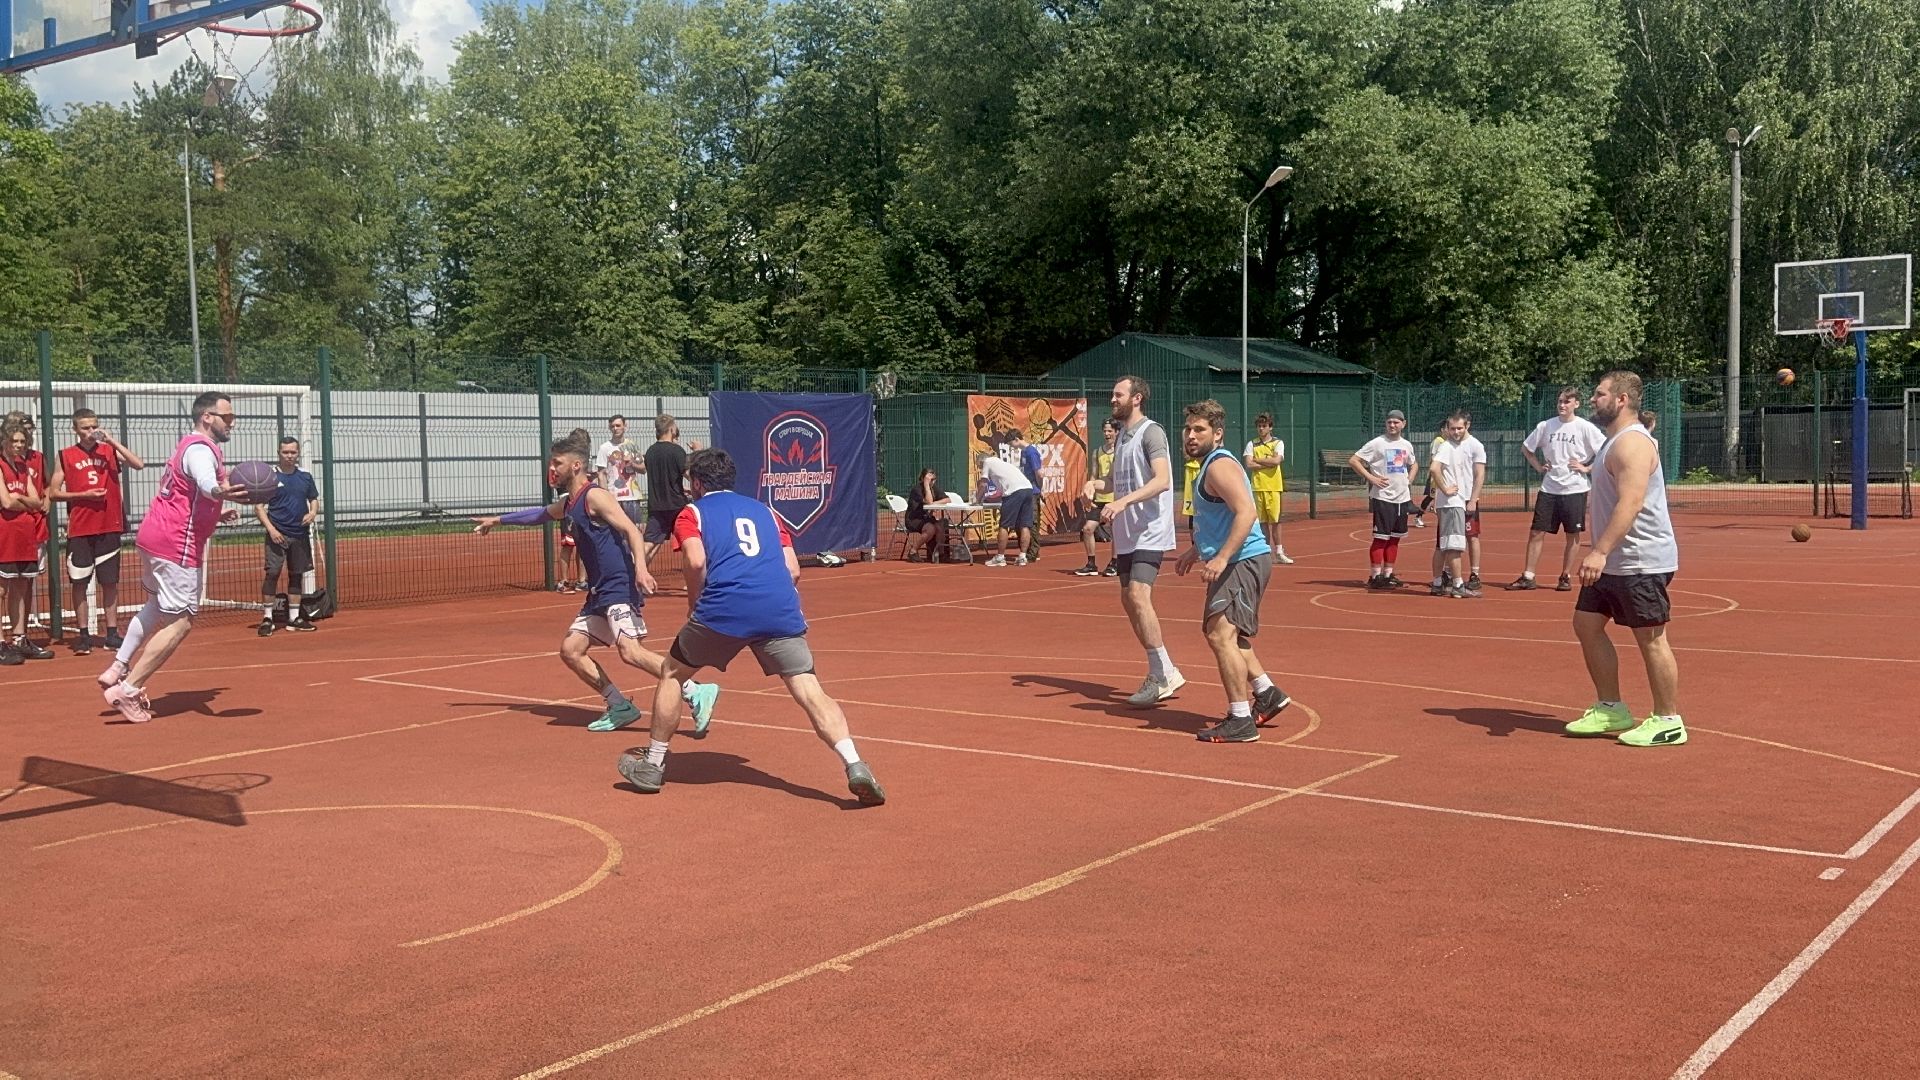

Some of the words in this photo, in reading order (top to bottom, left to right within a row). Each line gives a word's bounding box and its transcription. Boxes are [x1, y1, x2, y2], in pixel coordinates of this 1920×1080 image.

[1549, 432, 1576, 445] FILA
[88, 471, 98, 485] 5
[762, 469, 832, 487] ГВАРДЕЙСКАЯ
[774, 486, 820, 501] МАШИНА
[736, 518, 760, 557] 9
